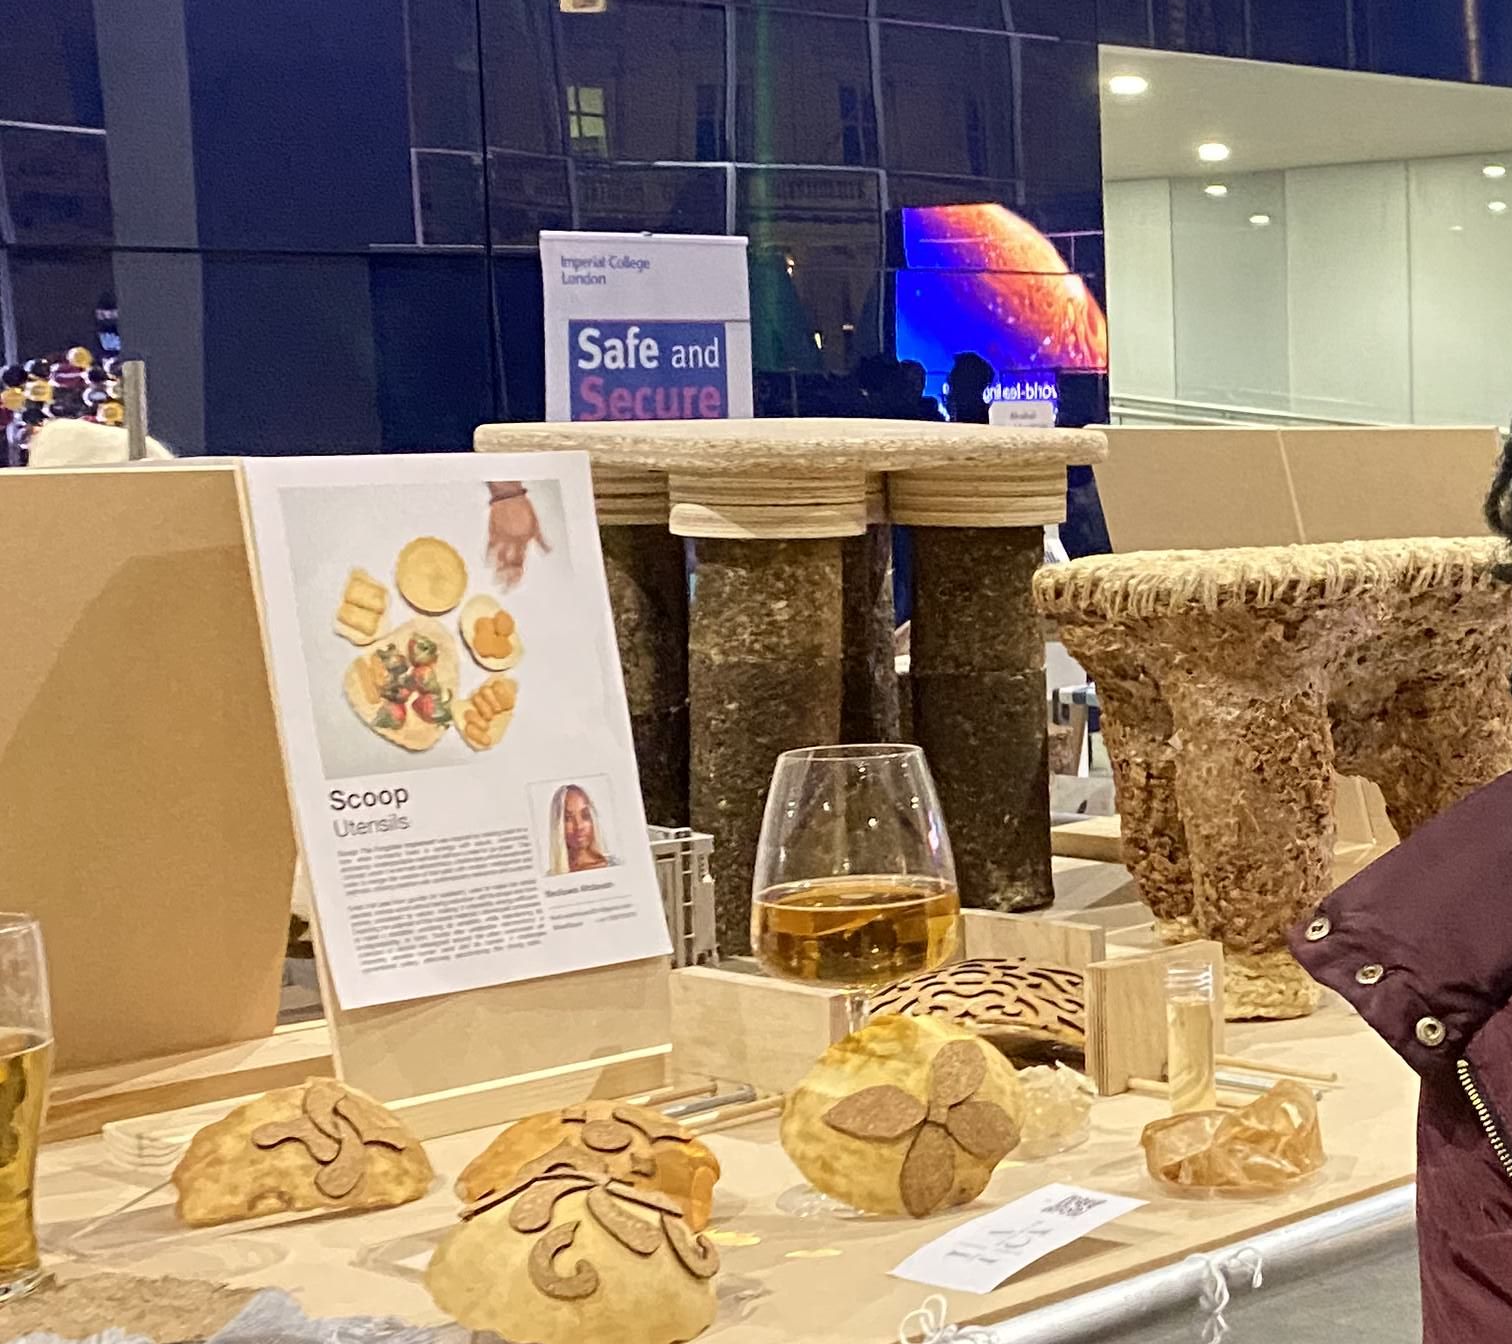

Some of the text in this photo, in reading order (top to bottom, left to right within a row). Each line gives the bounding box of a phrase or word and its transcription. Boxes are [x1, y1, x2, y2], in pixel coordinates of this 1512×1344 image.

[560, 255, 650, 273] Imperial College
[561, 271, 606, 285] London
[577, 326, 720, 370] Safe and
[580, 375, 721, 420] Secure
[330, 787, 409, 811] Scoop
[332, 813, 411, 838] Utensils
